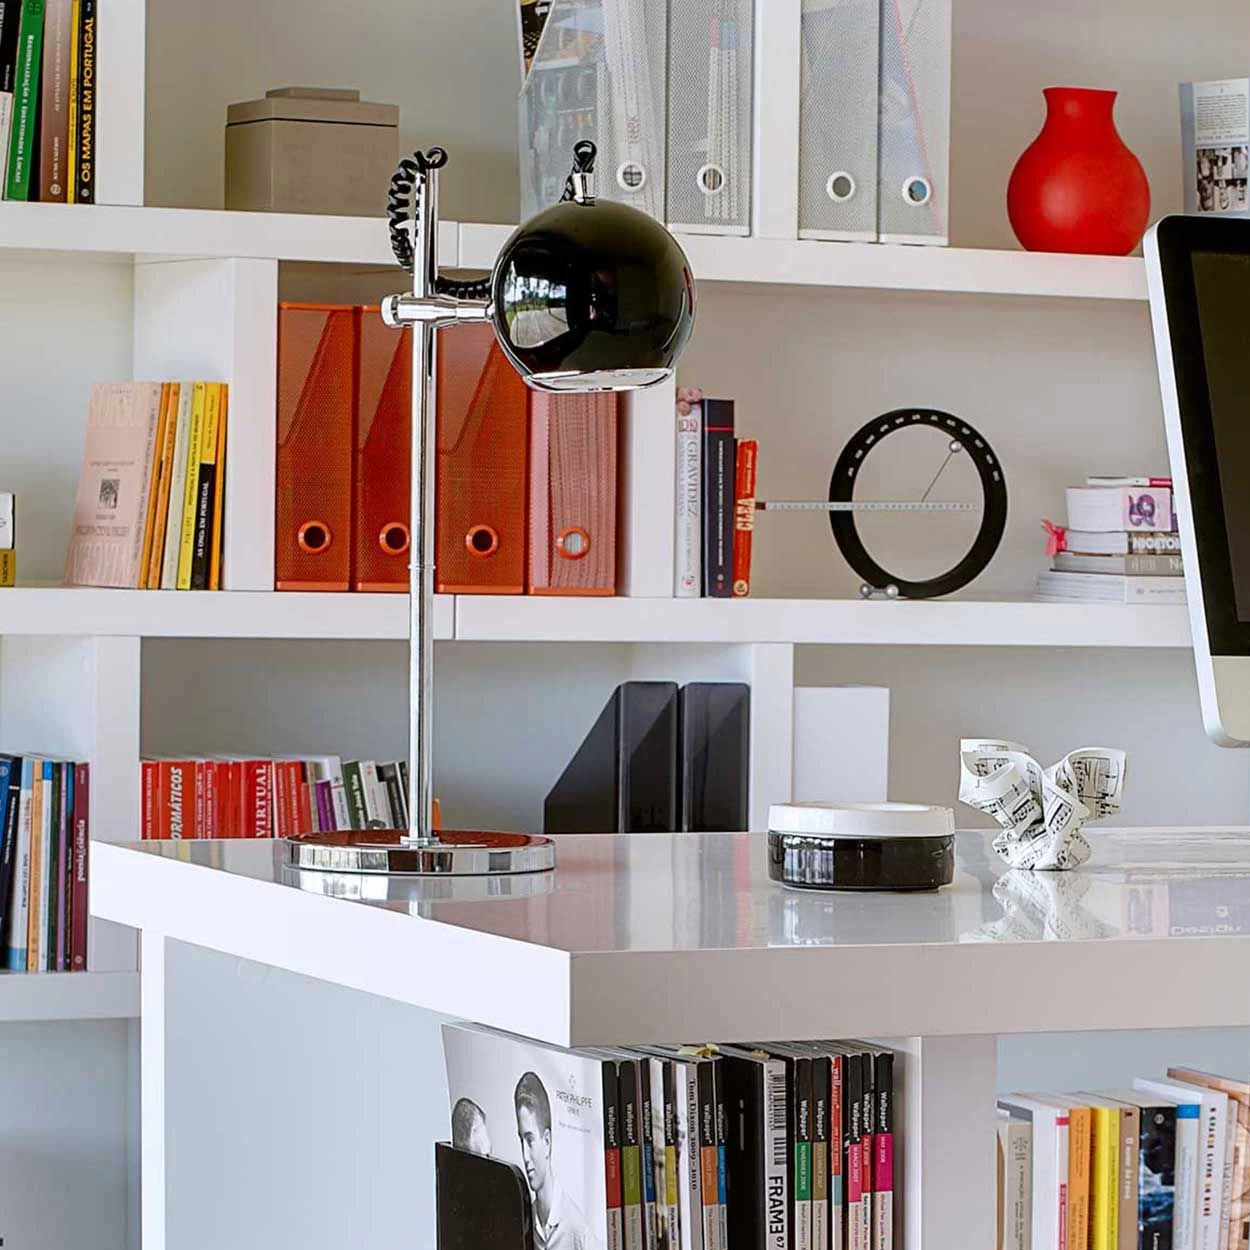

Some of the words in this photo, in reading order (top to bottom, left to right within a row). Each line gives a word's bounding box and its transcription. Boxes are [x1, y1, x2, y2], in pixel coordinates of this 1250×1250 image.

[83, 17, 94, 87] PORTUGAL
[83, 90, 92, 111] EM
[82, 114, 92, 159] MAPAS
[82, 162, 91, 182] OS
[687, 441, 697, 517] GRAVIDEZ
[736, 498, 754, 531] CLEA
[256, 765, 267, 836] VIRTUAL
[688, 1079, 696, 1101] Tom
[689, 1103, 697, 1133] Dixon
[776, 1236, 785, 1248] 67
